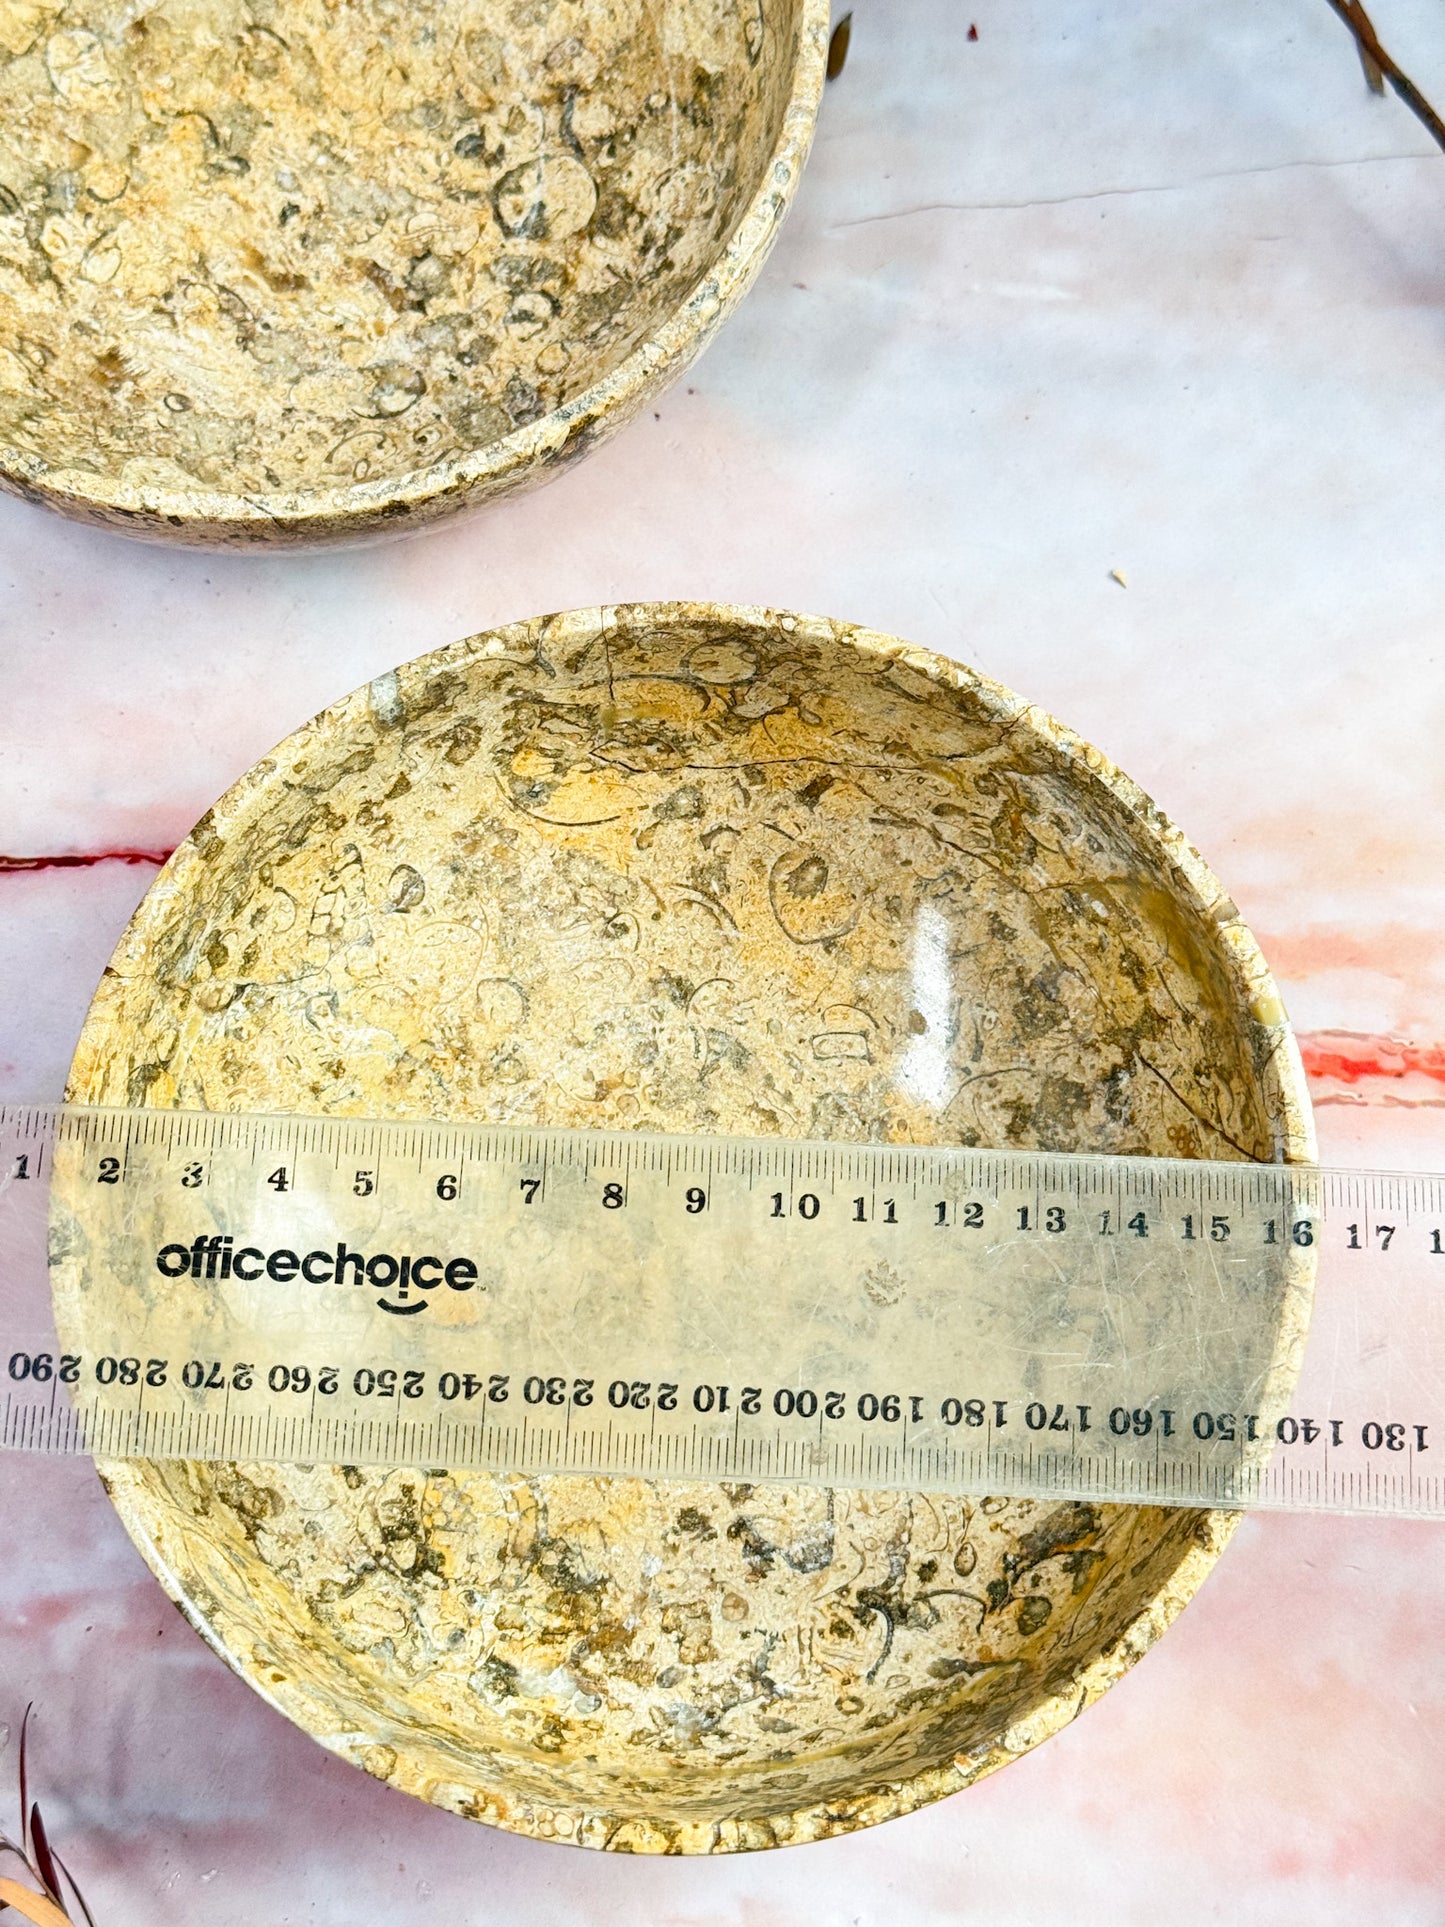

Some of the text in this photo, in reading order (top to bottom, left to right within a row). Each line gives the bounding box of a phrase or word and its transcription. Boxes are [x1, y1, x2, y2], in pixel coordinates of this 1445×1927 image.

[14, 1154, 1445, 1254] 1 2 3 4 5 6 7 8 9 10 11 12 13 14 15 16 17 1
[157, 1235, 479, 1300] officechoice
[8, 1353, 1429, 1450] 130 140 150 160 170 180 190 200 210 220 230 240 250 260 270 280 290
